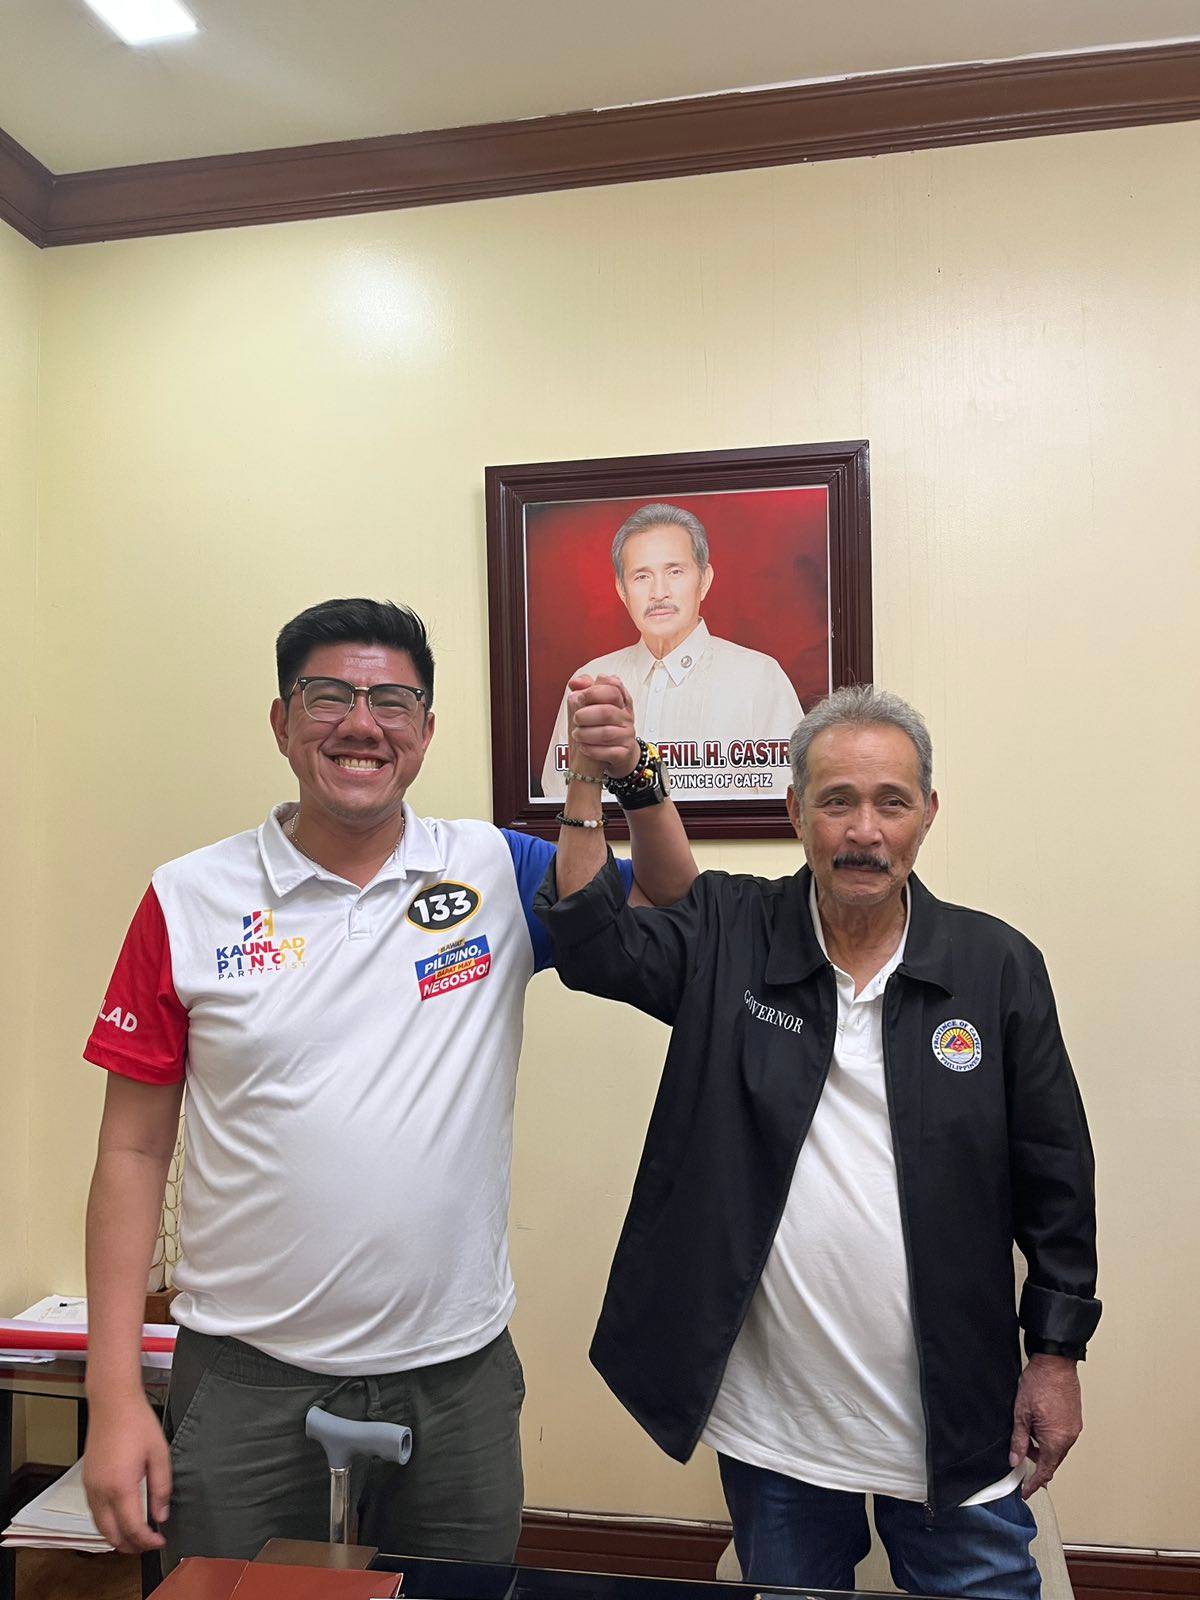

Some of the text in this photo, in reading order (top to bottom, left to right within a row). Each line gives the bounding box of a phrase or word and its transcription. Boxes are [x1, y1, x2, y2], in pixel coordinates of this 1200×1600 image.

[656, 742, 702, 768] ENIL
[704, 741, 727, 768] H.
[728, 739, 790, 768] CASTR
[669, 773, 772, 788] OVINCE OF CAPIZ
[413, 890, 472, 923] 133
[216, 937, 305, 960] KAUNLAD
[217, 949, 305, 973] PINOY
[424, 944, 482, 975] PILIPINO,
[423, 962, 489, 996] NEGOSYO!
[457, 960, 473, 971] MAY
[744, 989, 804, 1034] GOVERNOR
[934, 1020, 957, 1050] PROVINCE
